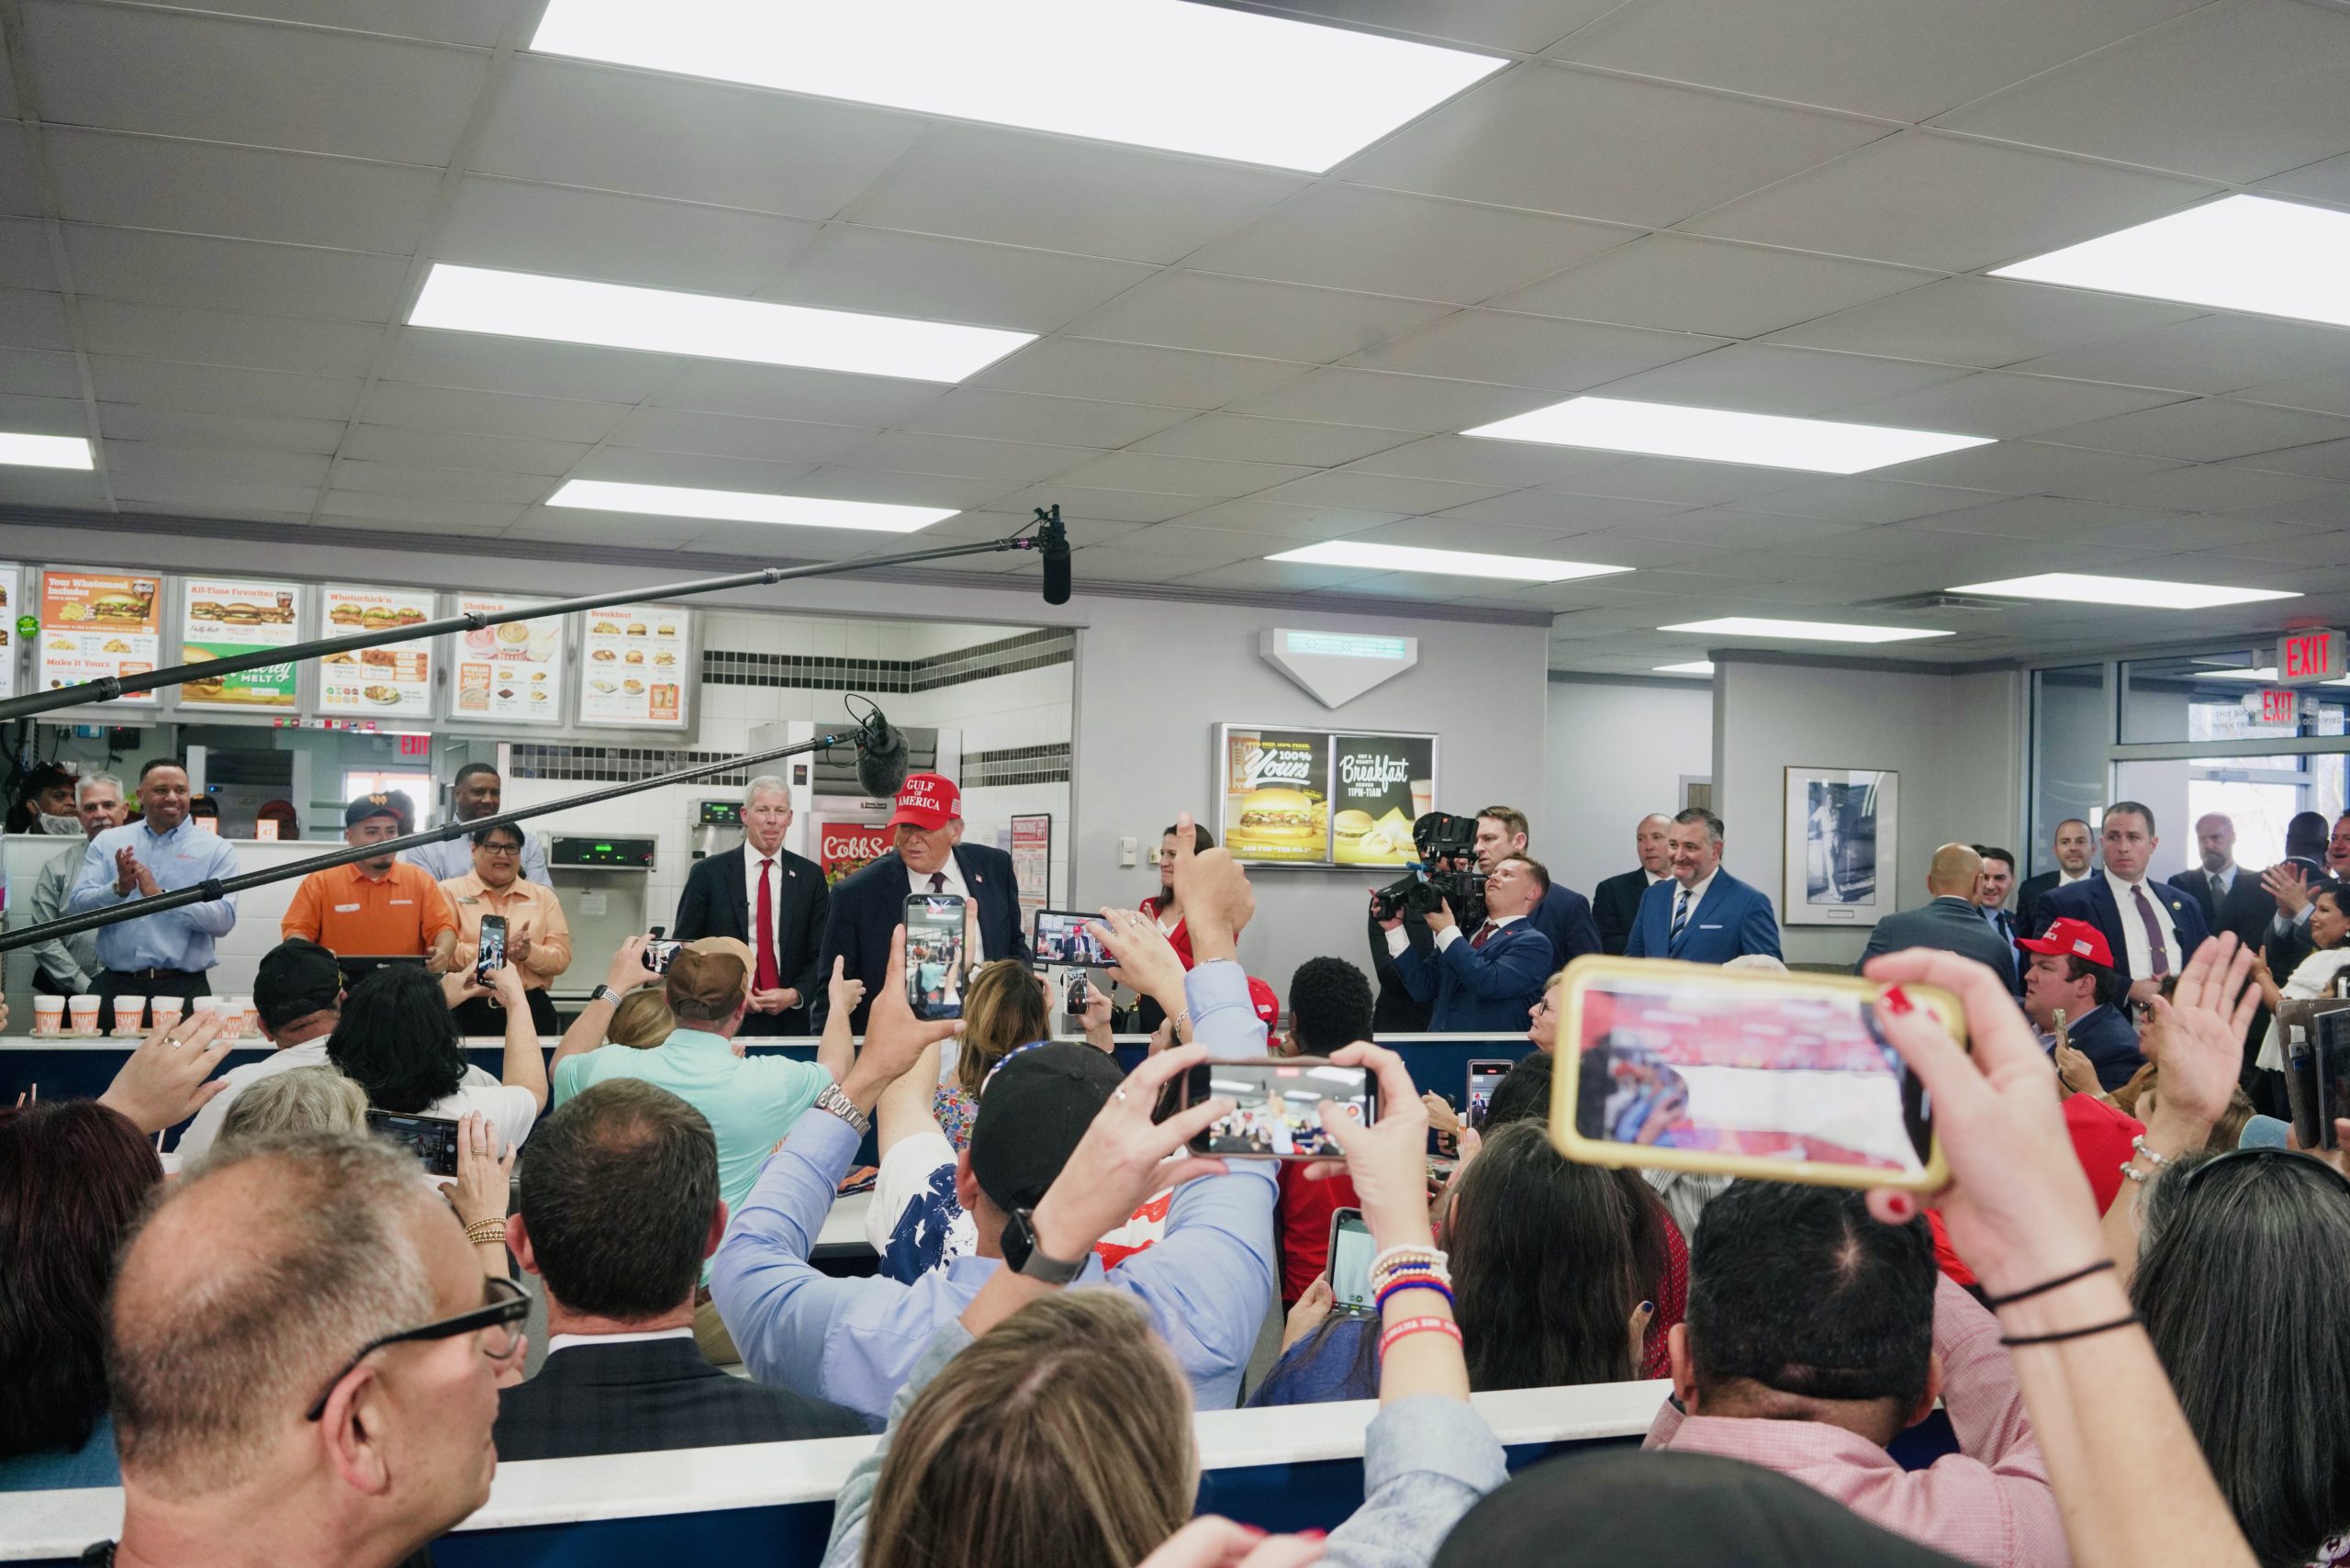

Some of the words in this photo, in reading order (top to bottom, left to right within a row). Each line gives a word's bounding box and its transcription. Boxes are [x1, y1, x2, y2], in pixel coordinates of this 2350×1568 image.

[48, 577, 71, 587] Your
[48, 588, 89, 596] Includes
[191, 587, 229, 595] All-Time
[231, 588, 274, 598] Favorites
[464, 602, 497, 611] Shakes
[2287, 634, 2331, 678] EXIT
[47, 658, 72, 666] Make
[84, 659, 110, 667] Yours
[241, 674, 273, 683] MELT
[2263, 690, 2293, 721] EXIT
[2302, 717, 2342, 726] OCCUPIED
[401, 735, 430, 756] EXIT
[1279, 750, 1312, 761] 100%
[1244, 748, 1312, 788] Yours
[1339, 754, 1409, 793] Breakfast
[906, 779, 935, 791] GULF
[1348, 787, 1382, 797] 11PM-11AM
[899, 795, 940, 811] AMERICA
[823, 835, 871, 859] Cobb
[869, 836, 894, 858] Sa
